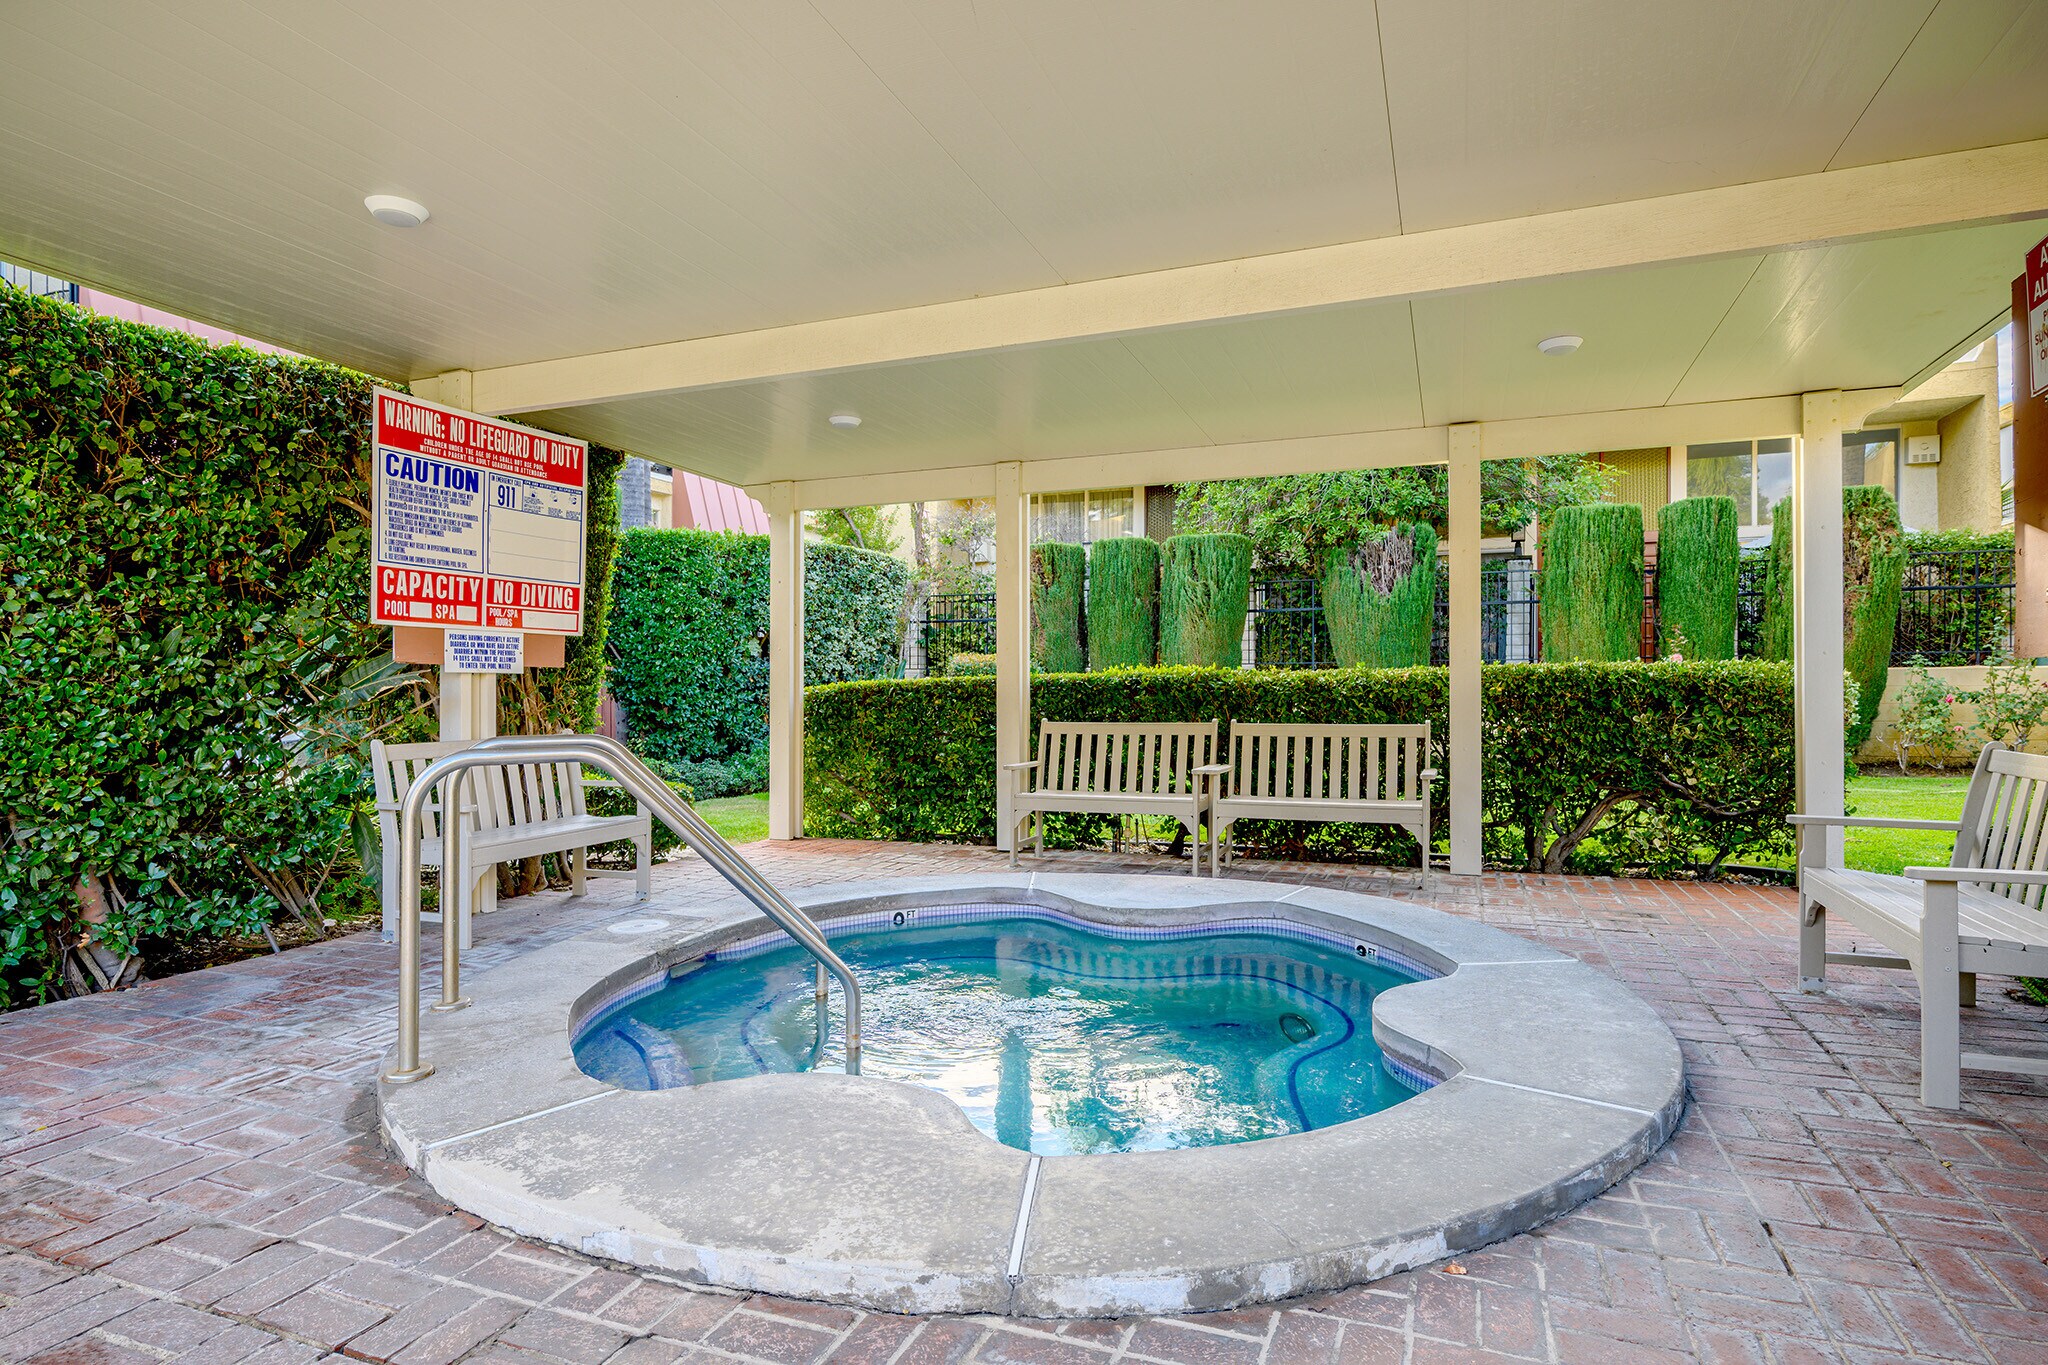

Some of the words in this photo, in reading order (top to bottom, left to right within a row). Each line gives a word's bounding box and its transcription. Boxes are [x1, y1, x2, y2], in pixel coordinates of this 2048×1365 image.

[385, 400, 445, 439] WARNING:
[450, 416, 465, 444] NO
[470, 421, 530, 459] LIFEGUARD
[538, 438, 547, 463] ON
[551, 442, 579, 470] DUTY
[420, 444, 441, 456] WITHOUT
[448, 451, 466, 461] PARENT
[468, 455, 474, 463] OR
[476, 457, 490, 466] ADULT
[492, 460, 513, 471] GUARDIAN
[520, 467, 547, 478] ATTENDANCE
[424, 438, 447, 450] CHILDREN
[448, 443, 463, 453] UNDER
[466, 447, 474, 455] THE
[476, 450, 484, 458] AGE
[493, 453, 498, 461] 14
[500, 455, 513, 464] SHALL
[514, 458, 522, 466] NOT
[533, 463, 544, 471] POOL
[386, 452, 479, 494] CAUTION
[498, 484, 515, 508] 911
[383, 569, 480, 602] CAPACITY
[494, 580, 514, 605] NO
[521, 583, 573, 610] DIVING
[384, 599, 409, 617] POOL
[436, 604, 455, 620] SPA
[489, 608, 518, 619] POOL/SPA
[495, 618, 513, 627] HOURS
